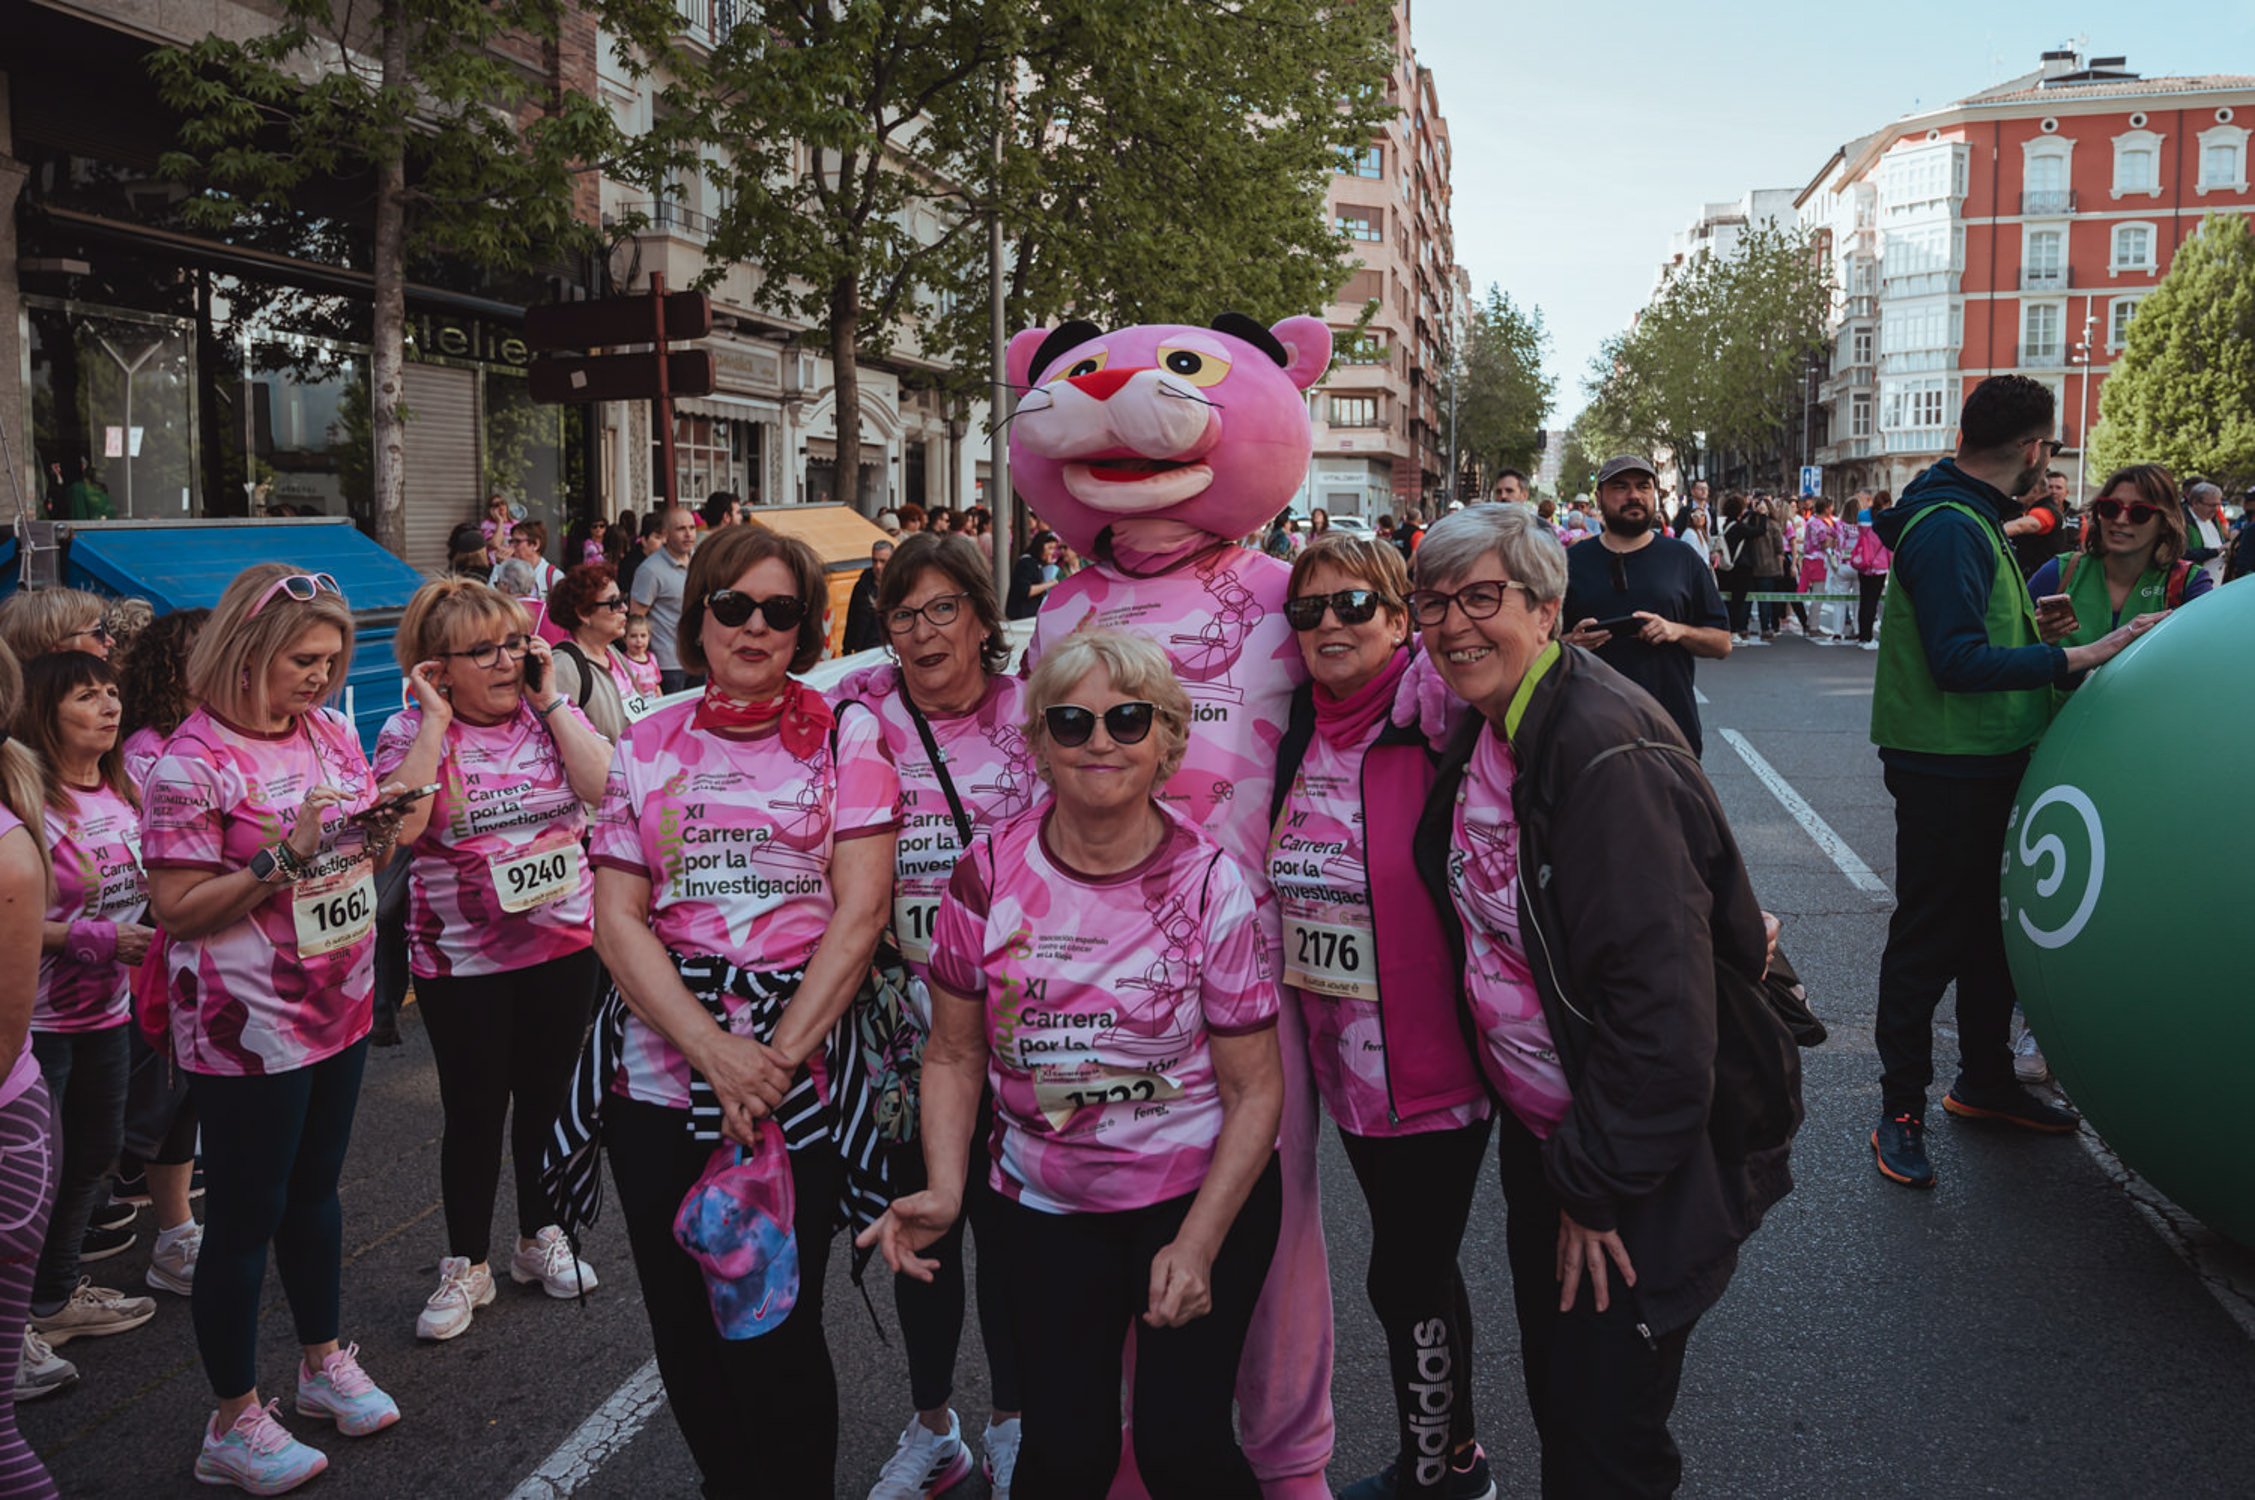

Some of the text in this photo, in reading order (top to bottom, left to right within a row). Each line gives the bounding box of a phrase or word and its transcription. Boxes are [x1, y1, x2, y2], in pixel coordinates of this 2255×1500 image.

[466, 773, 480, 786] XI
[467, 781, 532, 803] Carrera
[899, 790, 918, 807] XI
[278, 807, 298, 824] XI
[470, 800, 520, 824] por la
[473, 800, 578, 836] Investigación
[684, 803, 705, 821] XI
[901, 812, 974, 828] Carrea
[1288, 810, 1309, 828] XI
[682, 826, 770, 844] Carrera
[898, 832, 954, 857] por la
[1279, 833, 1344, 855] Carrera
[91, 846, 109, 861] XI
[685, 849, 747, 876] por la
[100, 861, 137, 878] Carre
[507, 854, 567, 894] 9240
[899, 855, 958, 876] Invest
[1272, 858, 1320, 878] por la
[102, 877, 135, 901] por la
[685, 874, 823, 900] Investigación
[1274, 880, 1366, 905] Investigac
[311, 886, 370, 932] 1662
[907, 905, 939, 939] 10
[1296, 927, 1360, 972] 2176
[1024, 978, 1047, 1000] XI
[1020, 1007, 1114, 1029] Carrera
[1019, 1036, 1091, 1057] por la
[1408, 1317, 1455, 1487] adidas
